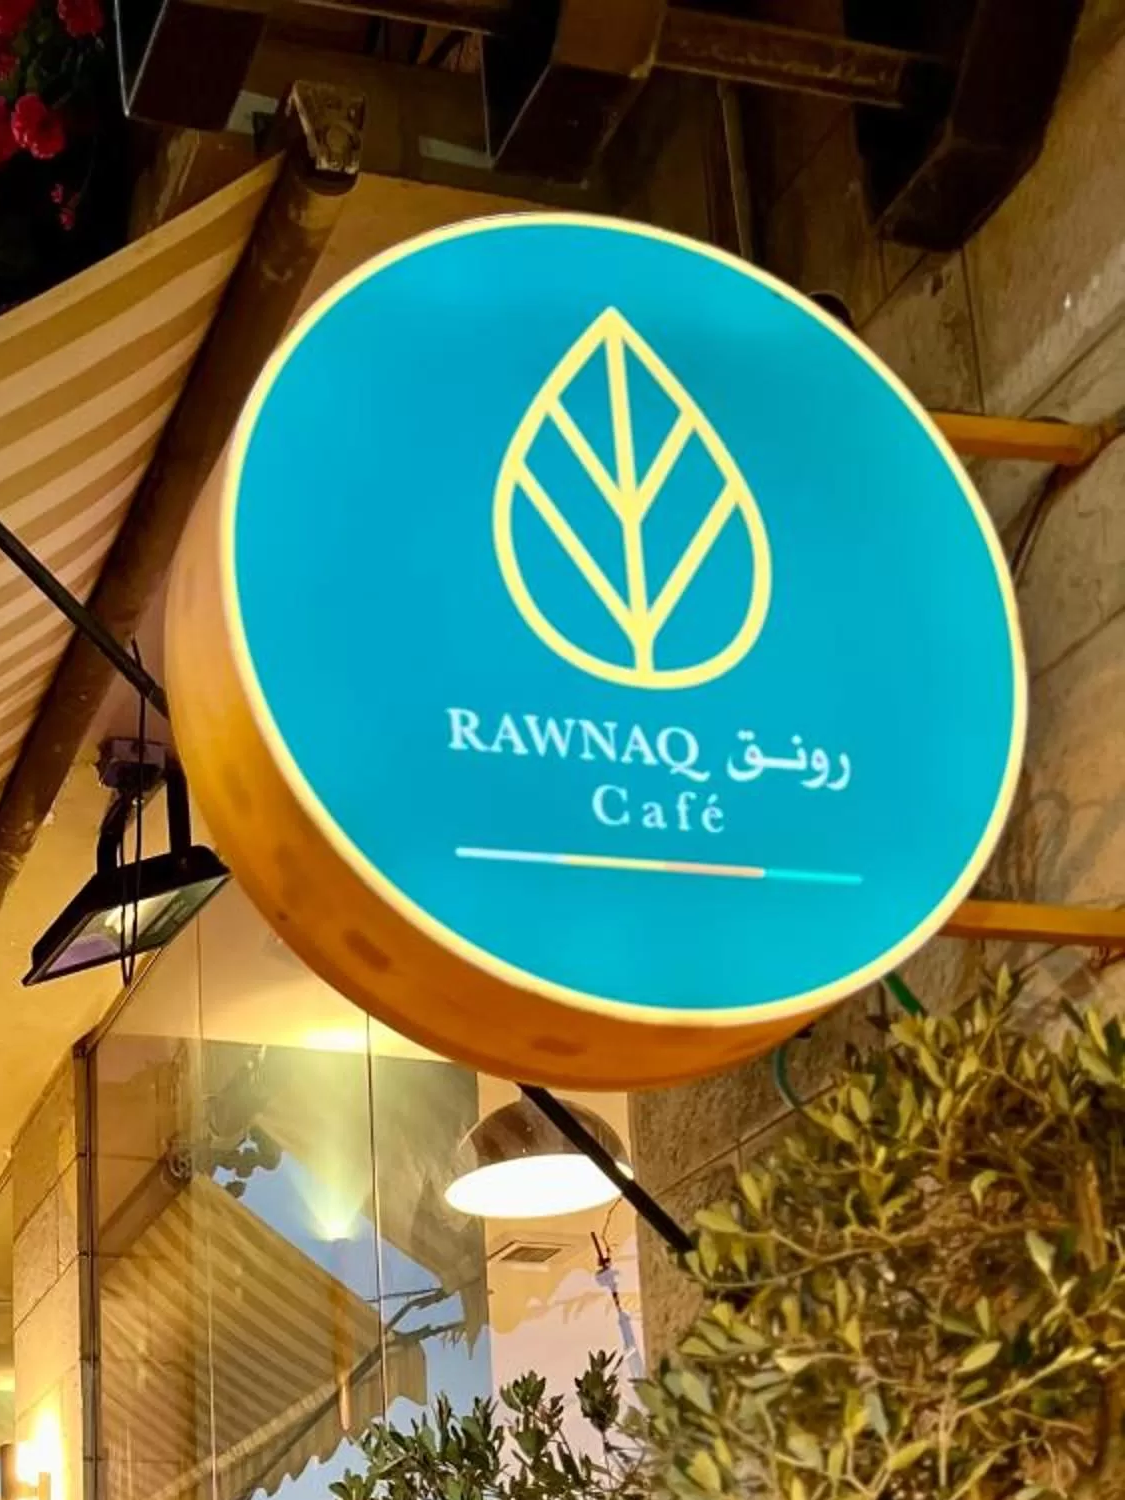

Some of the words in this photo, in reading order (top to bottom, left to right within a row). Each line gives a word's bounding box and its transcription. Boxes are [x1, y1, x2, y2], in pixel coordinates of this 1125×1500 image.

[446, 707, 709, 782] RAWNAQ
[726, 730, 851, 790] رونق
[591, 783, 725, 833] Café
